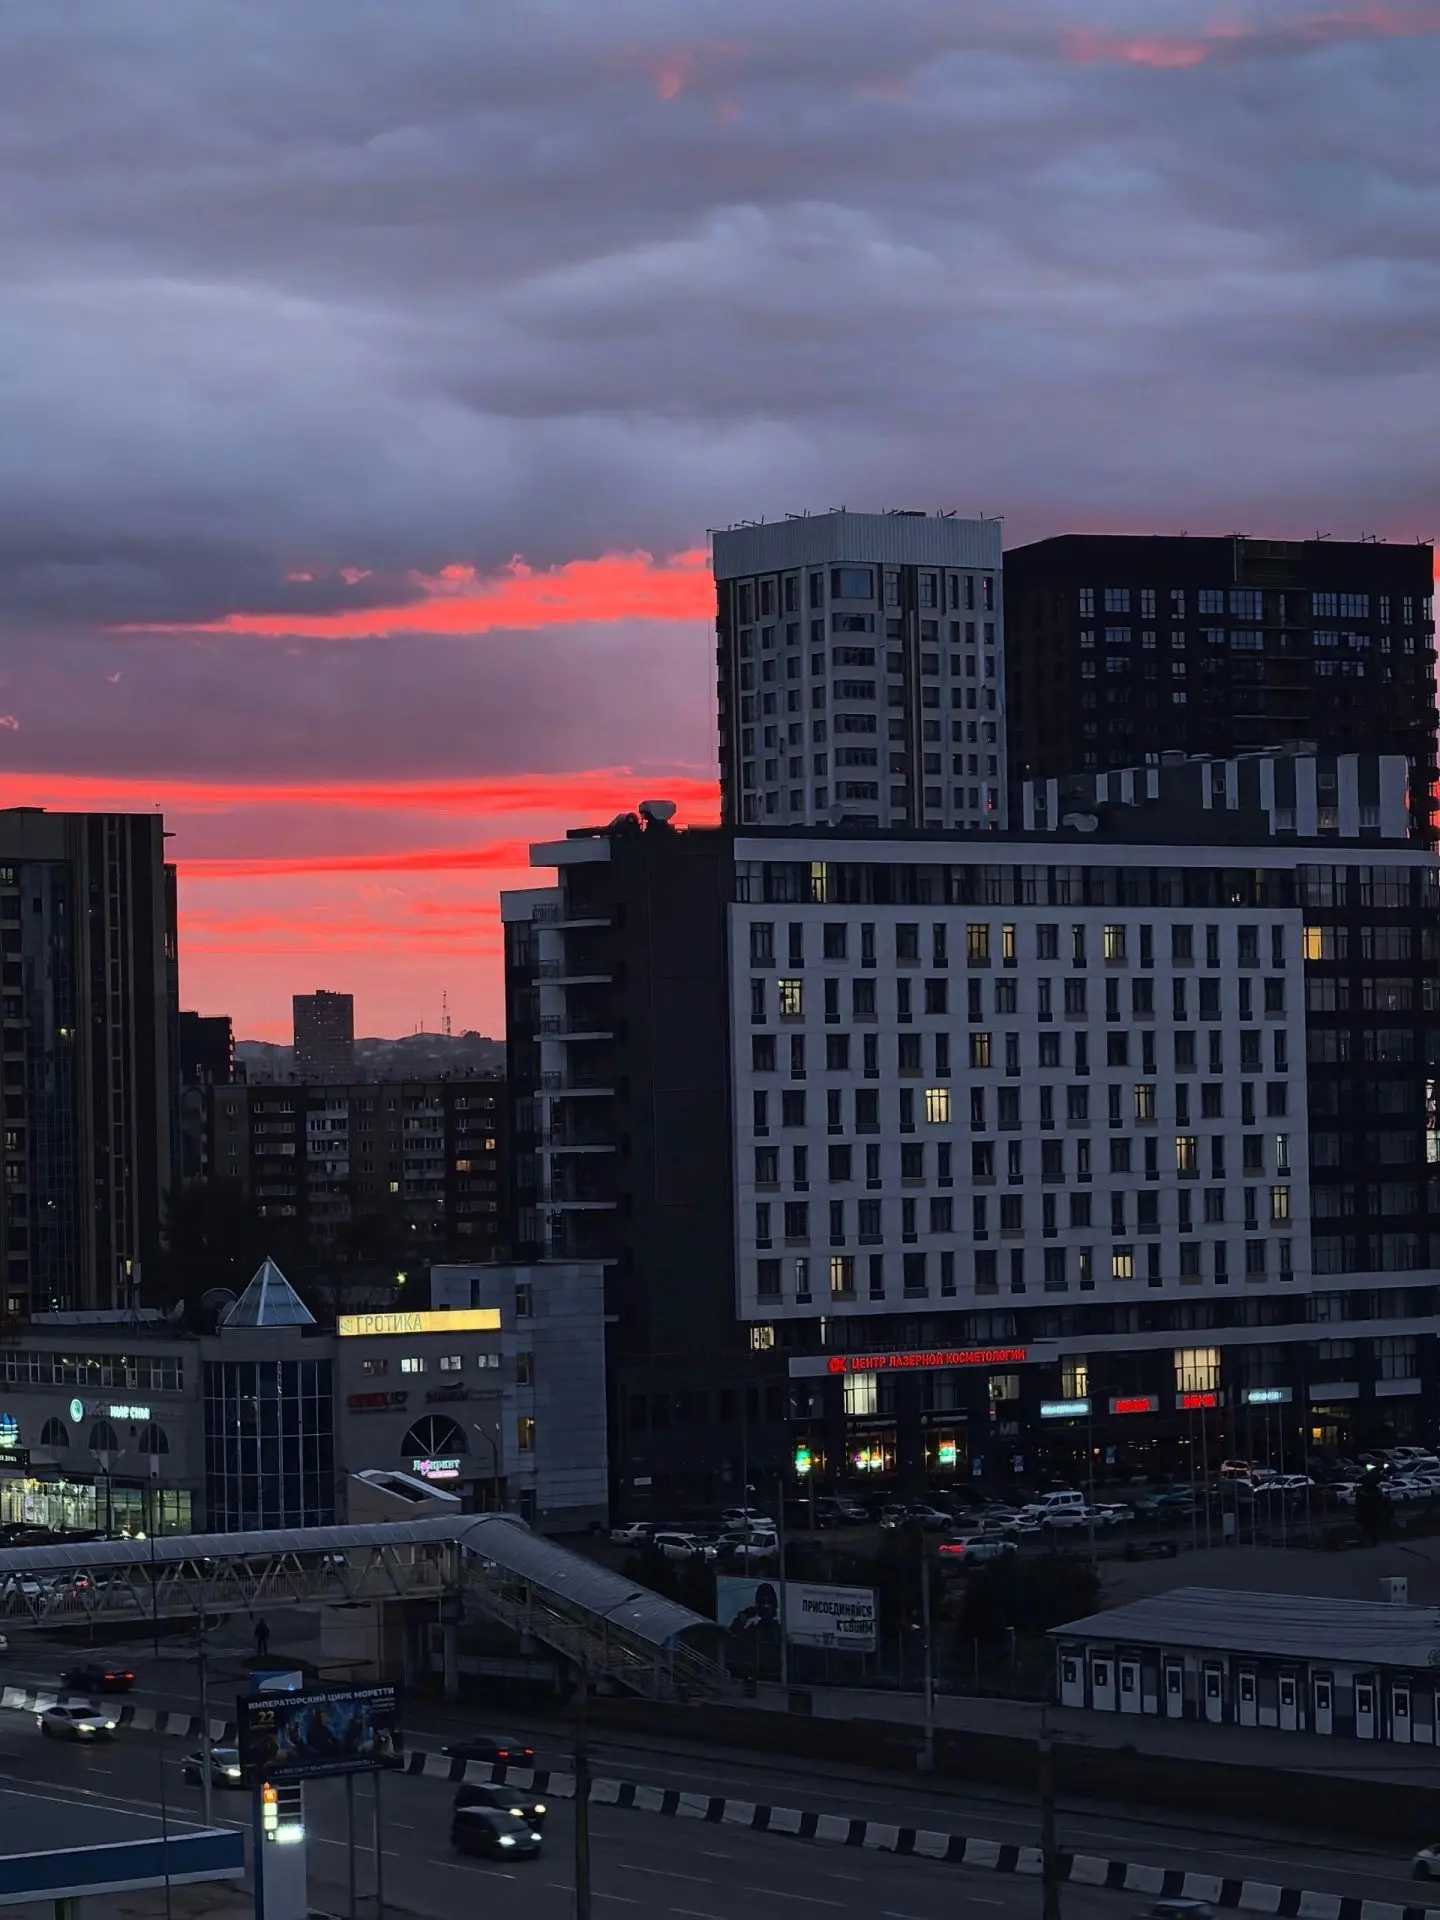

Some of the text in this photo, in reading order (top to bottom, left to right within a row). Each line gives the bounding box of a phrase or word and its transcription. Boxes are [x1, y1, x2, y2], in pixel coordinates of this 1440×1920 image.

[852, 1356, 886, 1372] ЦЕНТР
[889, 1352, 943, 1369] ЛАЗЕРНОЙ
[946, 1348, 1026, 1365] КОСМЕТОЛОГИИ
[802, 1600, 872, 1617] ПРИСОЕДИНЯЙСЯ
[248, 1686, 395, 1710] ИМПЕРАТОРСКИЙ ЦИРК МОРЕТТИ
[258, 1711, 275, 1722] 22
